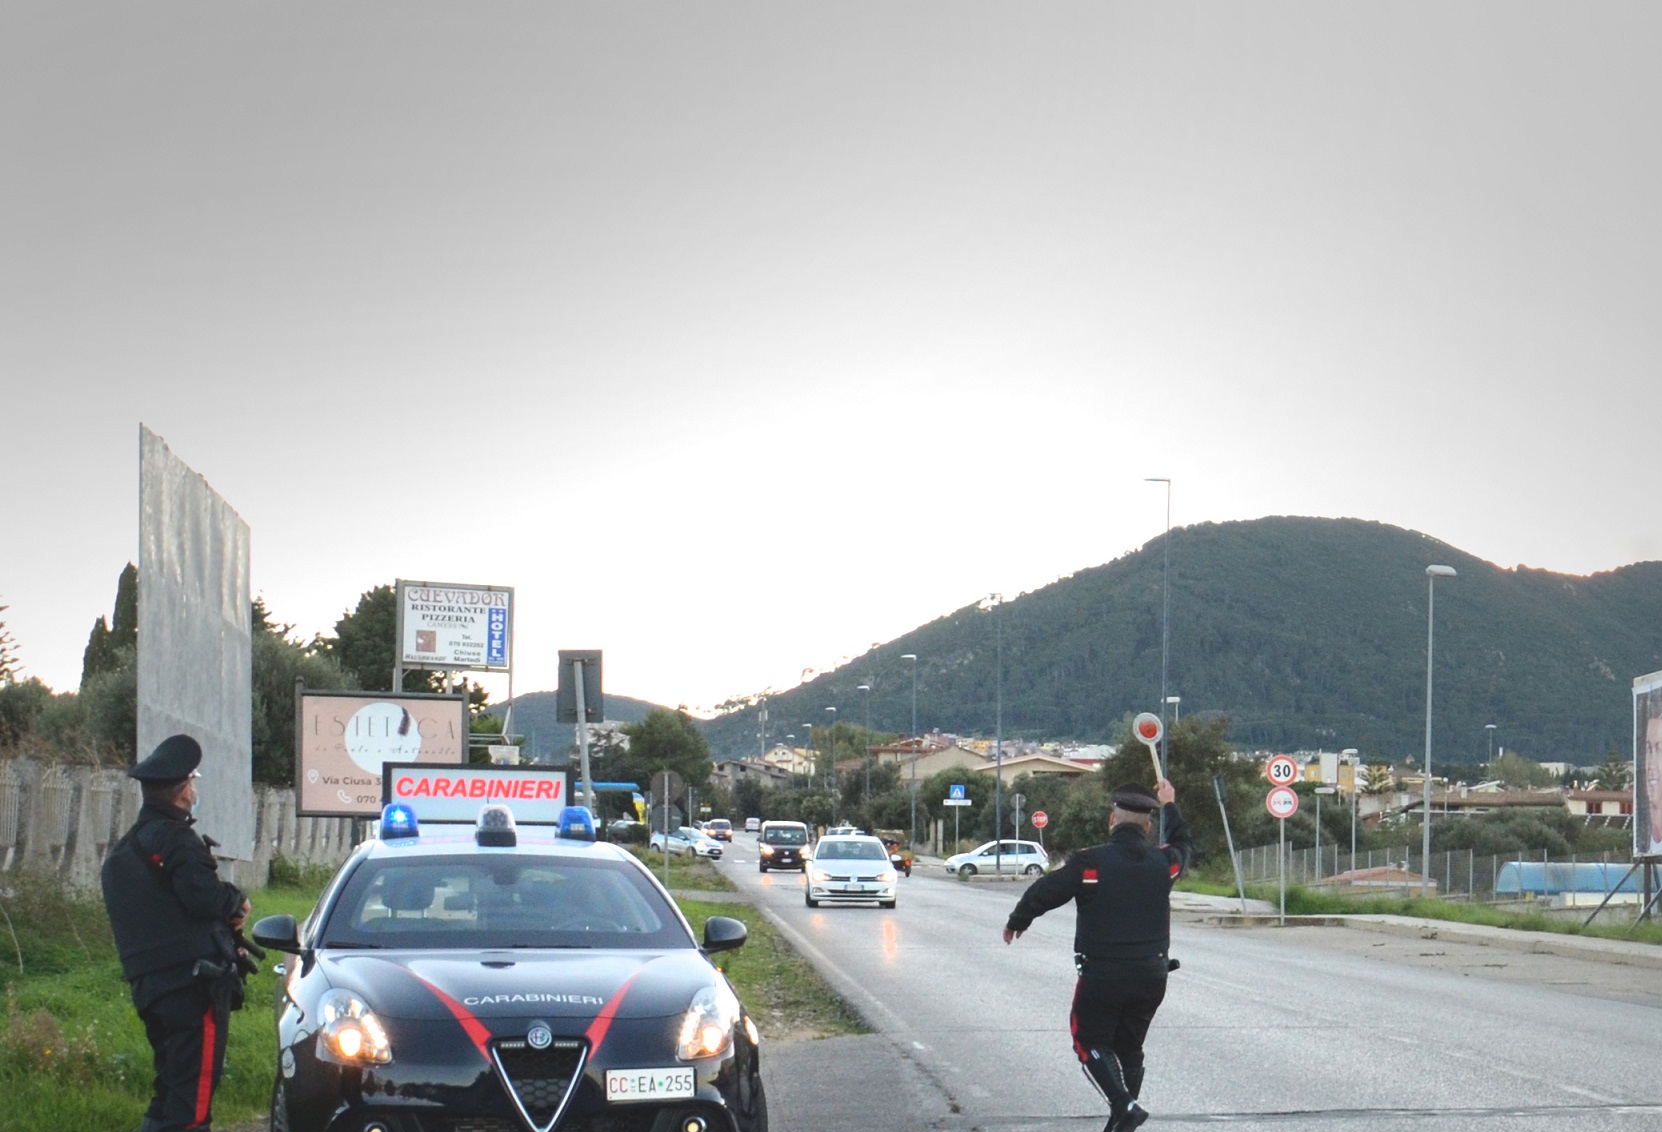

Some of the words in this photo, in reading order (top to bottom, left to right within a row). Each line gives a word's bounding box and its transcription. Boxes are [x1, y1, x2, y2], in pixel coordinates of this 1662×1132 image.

[407, 588, 506, 607] CUEVADOR
[411, 603, 486, 614] RISTORANTE
[422, 613, 475, 623] PIZZERIA
[491, 613, 504, 657] HOTEL
[1273, 764, 1291, 778] 30
[322, 777, 339, 785] Via
[342, 777, 372, 786] Ciusa
[395, 776, 561, 800] CARABINIERI
[356, 795, 376, 804] 070
[464, 993, 604, 1006] CARABINIERI
[608, 1076, 628, 1093] CC
